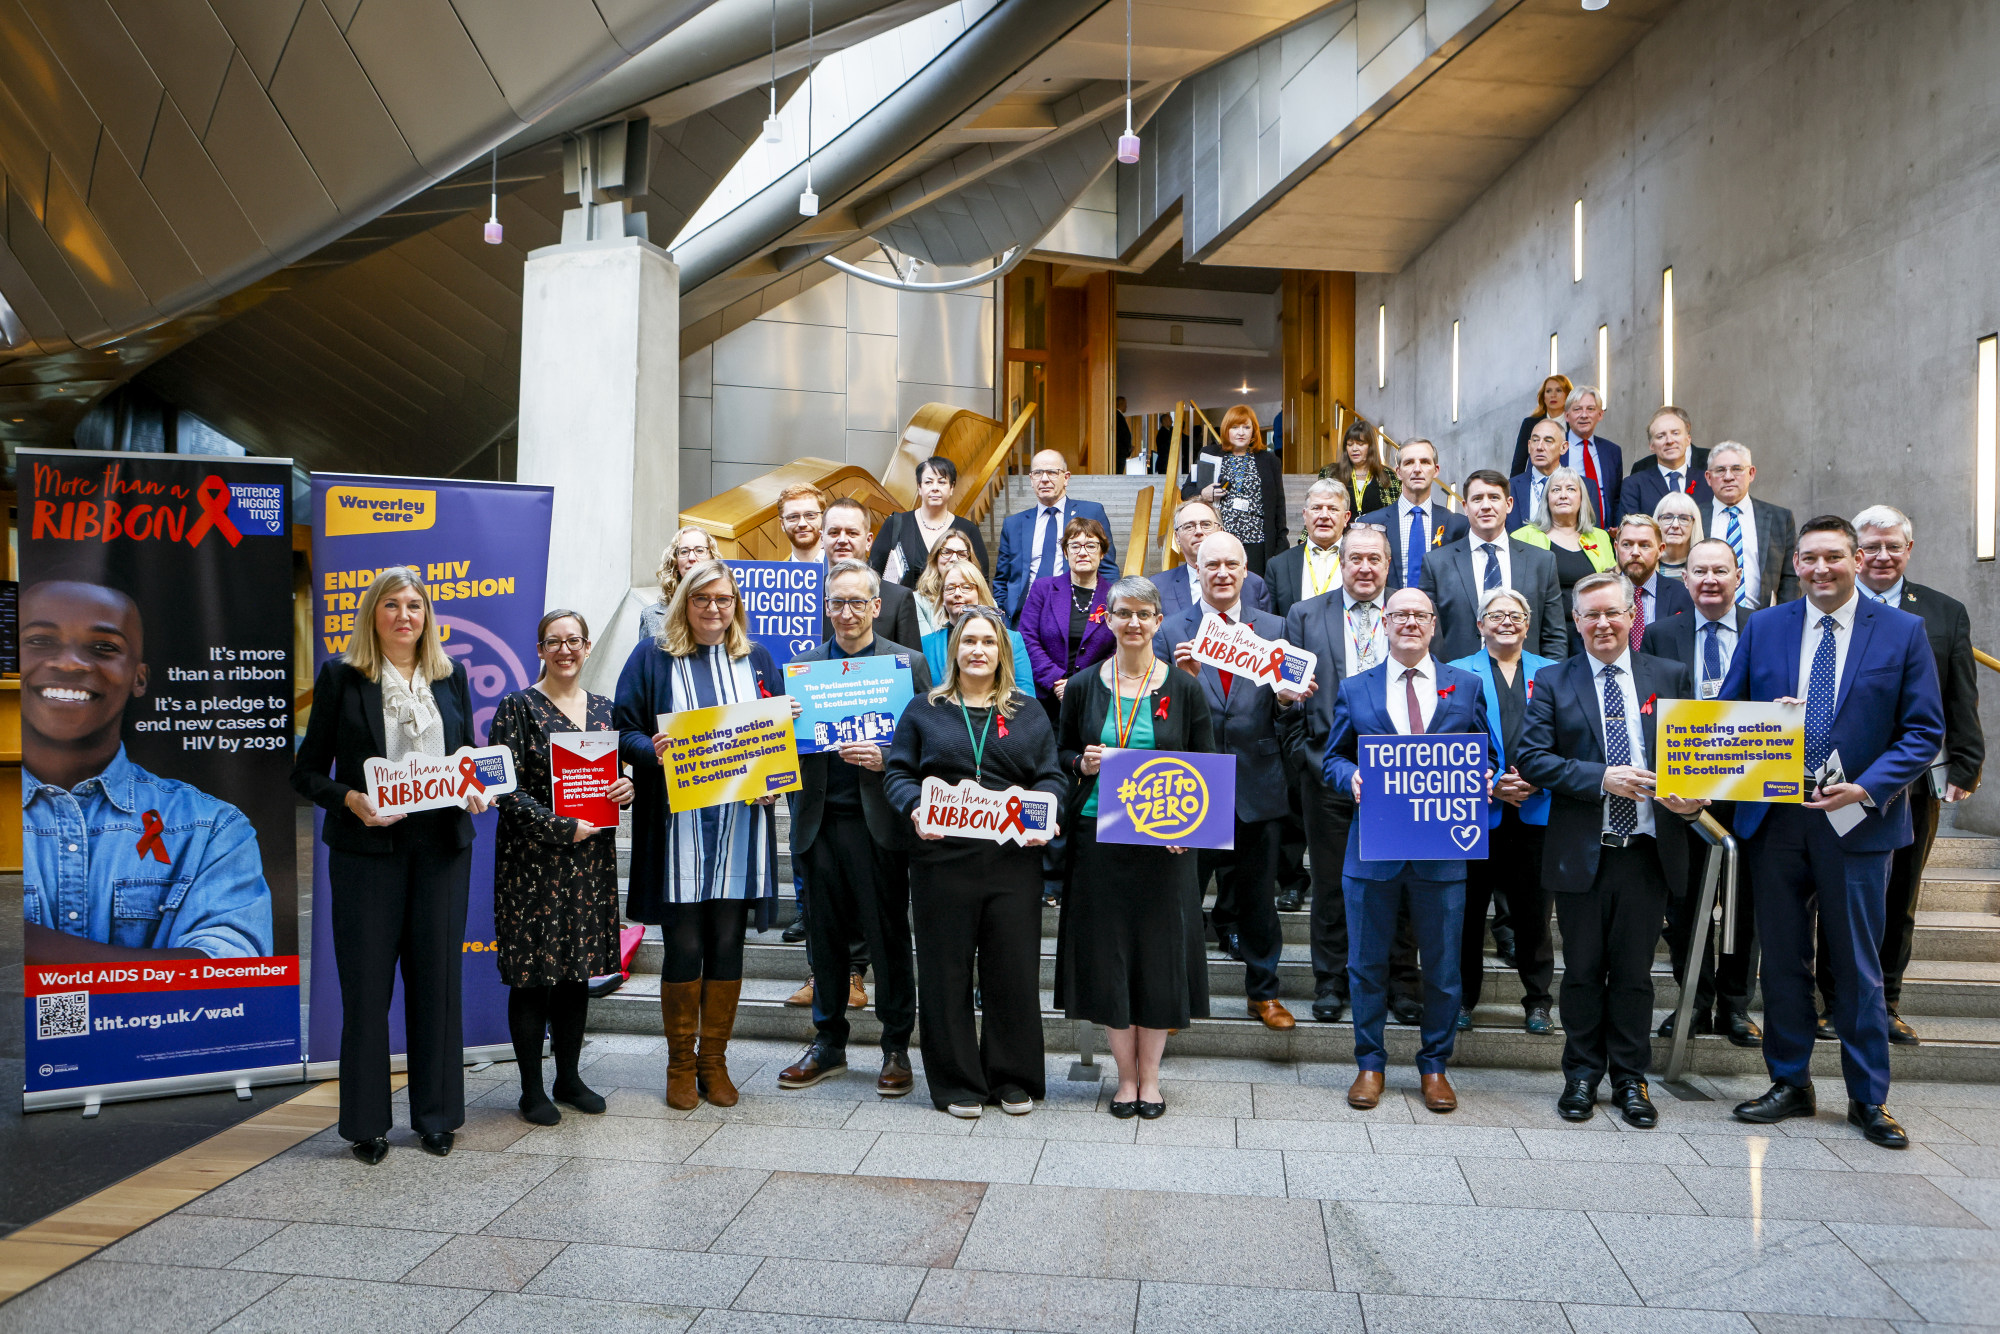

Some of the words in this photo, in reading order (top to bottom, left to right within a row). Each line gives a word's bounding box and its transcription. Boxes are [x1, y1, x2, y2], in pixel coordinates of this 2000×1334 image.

[34, 462, 98, 497] More
[103, 463, 165, 496] than
[171, 484, 190, 499] a
[338, 494, 425, 515] Waverley
[32, 500, 187, 543] RIBBON
[372, 511, 413, 523] care
[427, 560, 471, 581] HIV
[729, 567, 817, 589] errence
[1205, 620, 1231, 640] More
[1232, 630, 1259, 650] than
[1260, 646, 1268, 654] a
[210, 647, 236, 661] It's
[239, 649, 286, 660] more
[1198, 637, 1263, 672] RIBBON
[168, 667, 209, 681] than
[213, 669, 224, 680] a
[228, 666, 286, 680] ribbon
[804, 684, 819, 692] The
[820, 680, 862, 690] Parliament
[863, 679, 879, 687] that
[155, 697, 182, 711] It's
[185, 700, 197, 711] a
[201, 696, 265, 714] pledge
[268, 696, 286, 709] to
[823, 699, 857, 708] Scotland
[858, 697, 867, 705] by
[135, 717, 171, 731] end
[175, 719, 213, 731] new
[216, 718, 266, 730] cases
[269, 714, 288, 728] of
[1666, 724, 1687, 734] I'm
[1690, 723, 1735, 735] taking
[1738, 722, 1782, 733] action
[183, 736, 215, 750] HIV
[218, 735, 240, 752] by
[243, 736, 286, 750] 2030
[670, 737, 690, 749] I'm
[691, 727, 733, 744] taking
[735, 719, 774, 734] action
[1666, 738, 1681, 747] to
[1683, 737, 1763, 747] #GetToZero
[1766, 738, 1795, 746] new
[672, 751, 686, 762] to
[688, 736, 760, 758] #GetToZero
[761, 730, 786, 742] new
[1667, 752, 1691, 761] HIV
[1694, 750, 1792, 761] transmissions
[674, 762, 697, 775] HIV
[700, 743, 787, 768] transmissions
[374, 766, 407, 785] More
[409, 759, 442, 779] than
[445, 764, 454, 773] a
[677, 778, 690, 789] in
[692, 764, 748, 786] Scotland
[1667, 765, 1681, 775] in
[1684, 765, 1744, 775] Scotland
[377, 776, 455, 808] RIBBON
[563, 787, 583, 795] people
[930, 785, 959, 803] More
[961, 787, 991, 805] than
[927, 805, 1000, 830] RIBBON
[1135, 795, 1199, 832] ZERO
[38, 970, 93, 986] World
[97, 968, 139, 983] AIDS
[142, 967, 175, 984] Day
[190, 968, 199, 979] 1
[203, 964, 288, 979] December
[94, 1002, 245, 1031] tht.org.uk/wad
